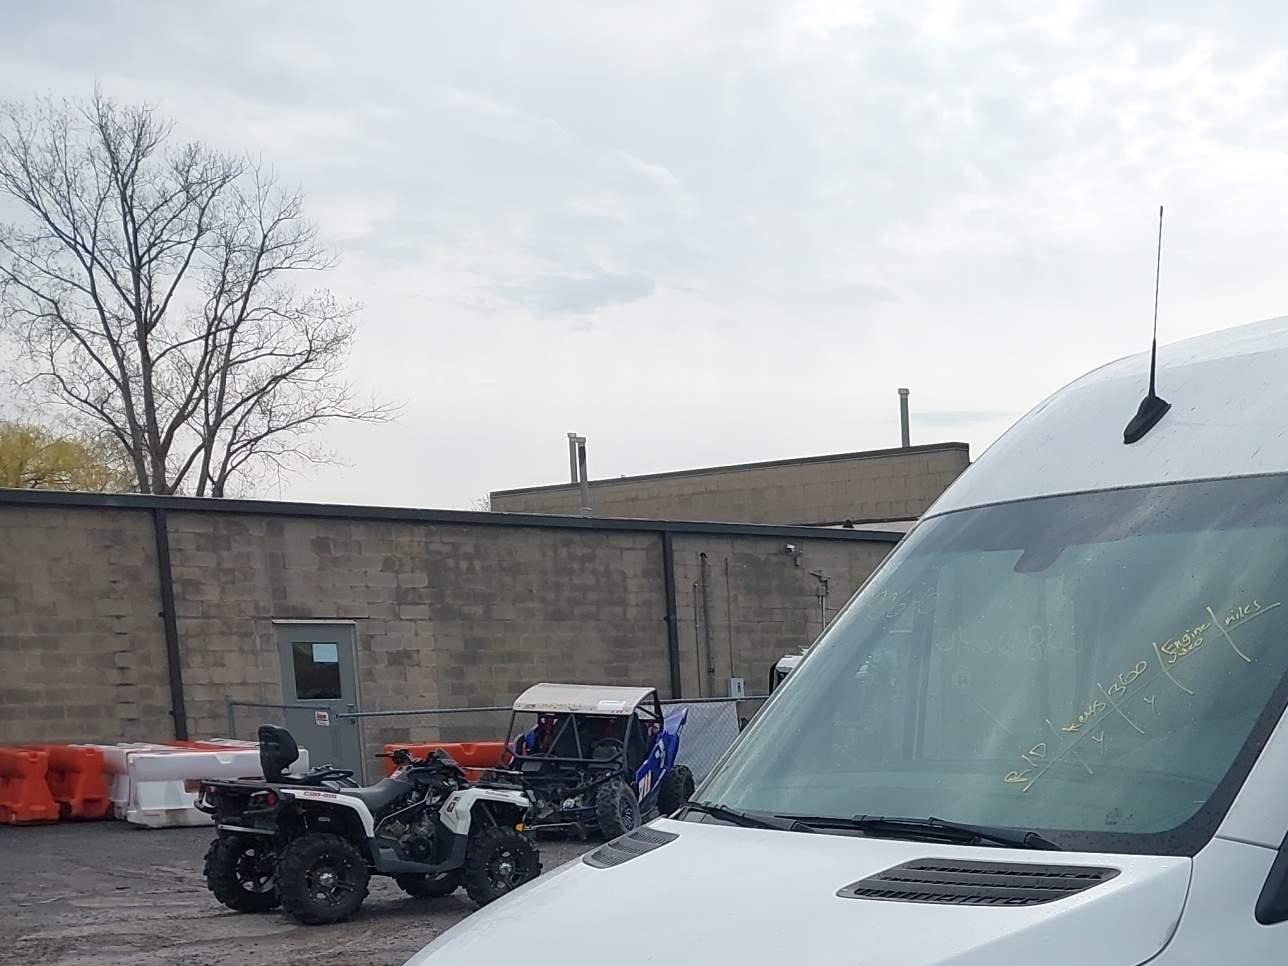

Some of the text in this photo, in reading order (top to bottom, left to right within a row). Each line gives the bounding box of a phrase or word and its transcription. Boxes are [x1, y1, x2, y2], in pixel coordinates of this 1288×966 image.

[1107, 660, 1147, 697] 360
[1160, 622, 1212, 655] Engine
[1224, 599, 1261, 626] miles
